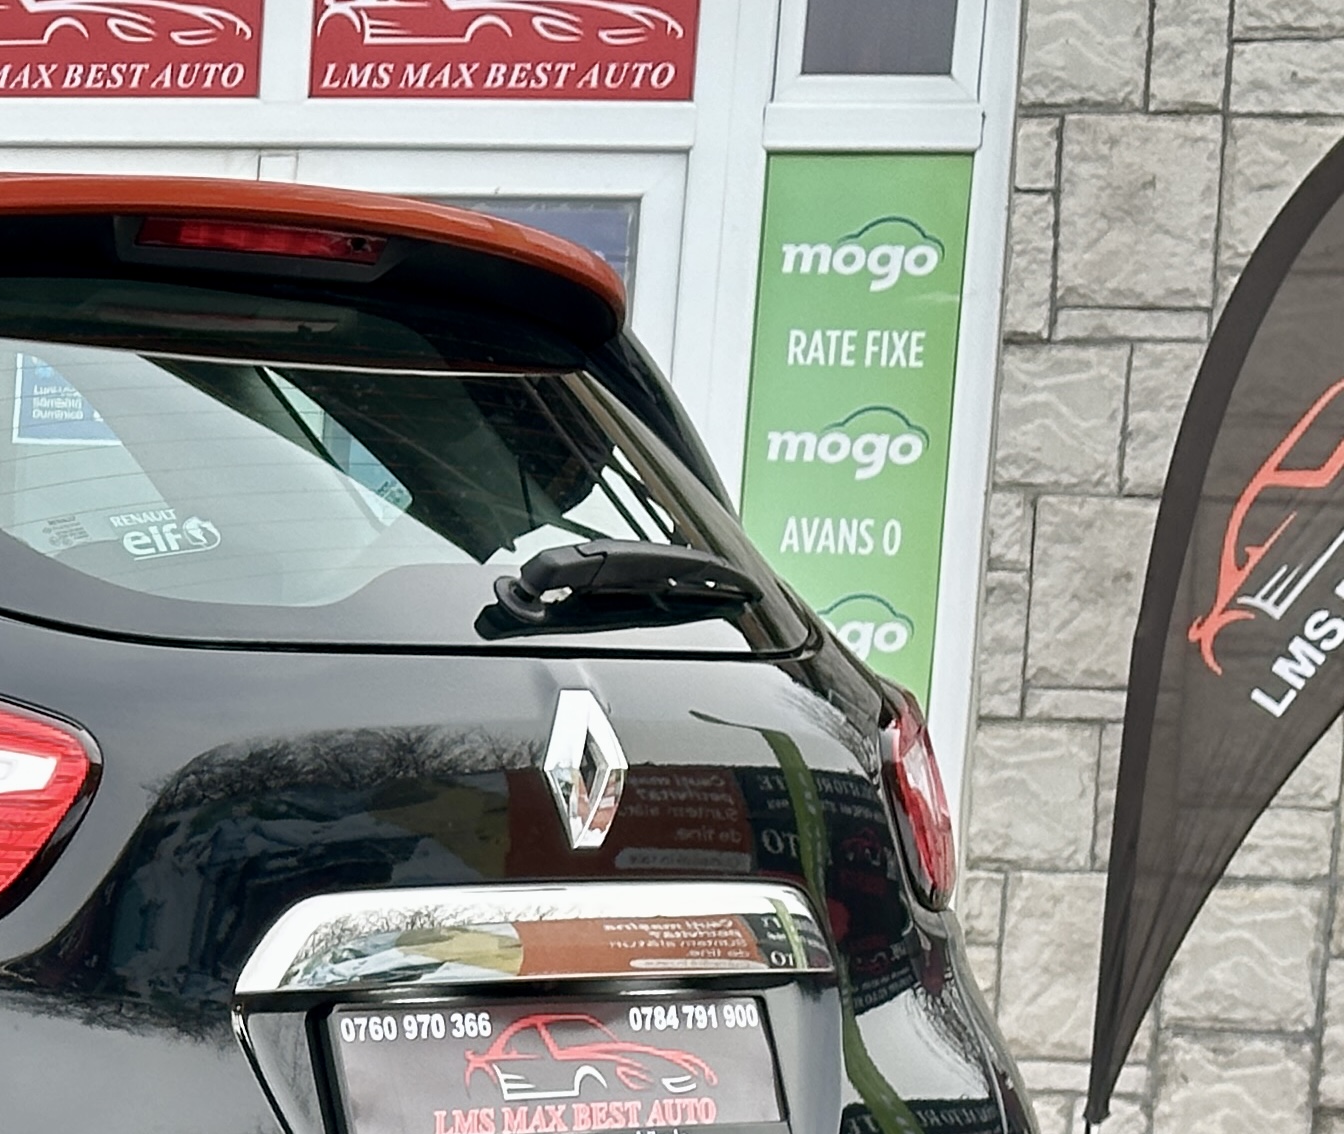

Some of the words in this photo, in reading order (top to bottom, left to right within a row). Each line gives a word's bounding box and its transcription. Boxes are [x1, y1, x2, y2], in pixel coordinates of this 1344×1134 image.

[62, 63, 150, 89] BEST
[151, 63, 245, 89] AUTO
[321, 62, 394, 89] LMS
[398, 62, 480, 89] MAX
[484, 62, 576, 89] BEST
[577, 62, 676, 89] AUTO
[781, 243, 939, 292] mogo
[787, 329, 858, 366] RATE
[864, 330, 926, 369] FIXE
[767, 431, 924, 480] mogo
[110, 509, 176, 527] RENAULT
[123, 523, 182, 555] elf
[780, 516, 874, 556] AVANS
[1251, 609, 1344, 717] LMS
[341, 1016, 397, 1042] 0760
[403, 1013, 446, 1039] 970
[450, 1012, 492, 1038] 366
[629, 1005, 679, 1031] 0784
[682, 1004, 717, 1029] 791
[723, 1004, 759, 1028] 900
[502, 1104, 568, 1134] MAX
[572, 1101, 641, 1131] BEST
[646, 1097, 717, 1126] AUTO
